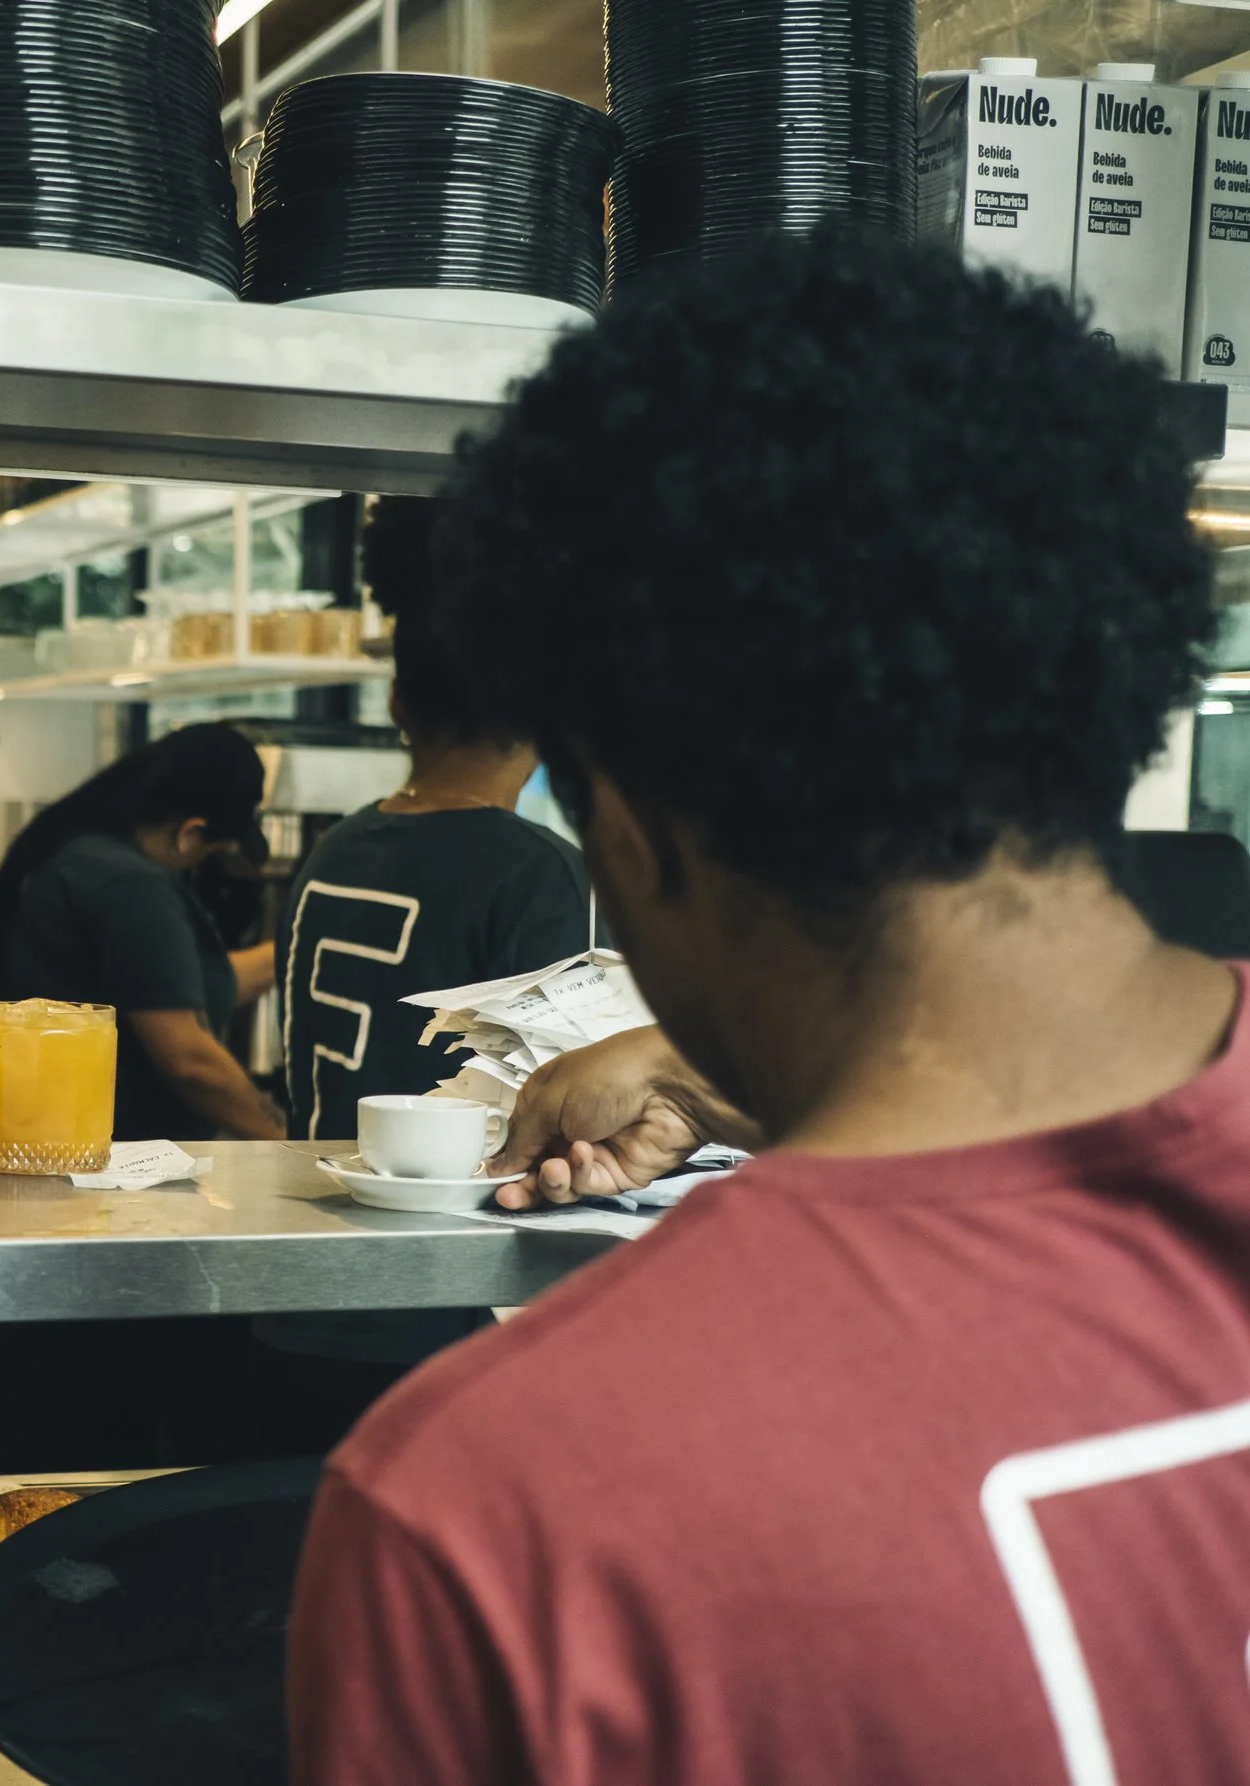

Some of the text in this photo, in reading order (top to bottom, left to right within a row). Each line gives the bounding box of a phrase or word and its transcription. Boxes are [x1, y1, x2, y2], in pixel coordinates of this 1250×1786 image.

[979, 85, 1057, 128] Nude.
[1095, 93, 1172, 136] Nude.
[978, 144, 1012, 161] Bebida
[1093, 151, 1126, 168] Bebida
[978, 162, 1020, 179] de aveia
[1215, 158, 1248, 175] Bebida
[1092, 169, 1134, 187] de aveia
[1214, 176, 1226, 190] de
[1000, 195, 1026, 208] Barista
[1113, 202, 1140, 215] Barista
[976, 211, 991, 224] Sem
[1090, 218, 1104, 231] Sem
[1211, 225, 1226, 237] Sem
[1210, 341, 1230, 359] 043
[567, 981, 585, 993] VEM
[284, 880, 420, 1140] F
